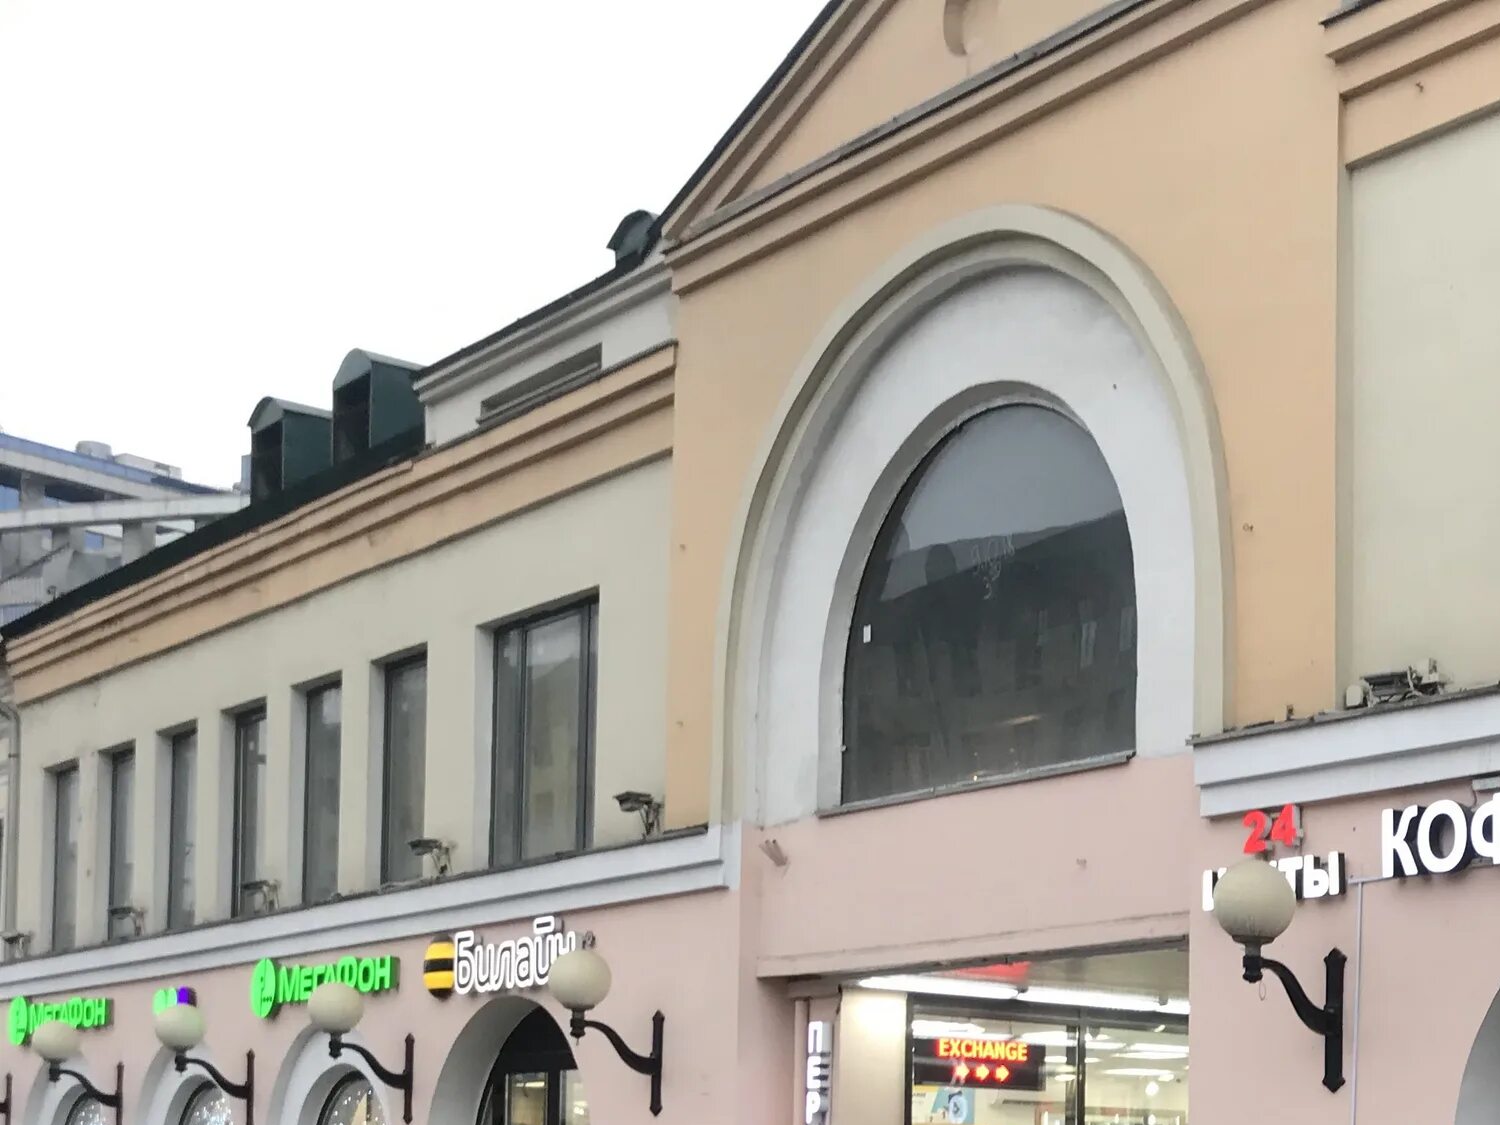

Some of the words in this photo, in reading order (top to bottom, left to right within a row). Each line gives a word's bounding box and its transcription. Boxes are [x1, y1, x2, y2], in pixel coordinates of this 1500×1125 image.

[1241, 802, 1297, 855] 24
[277, 954, 391, 1004] МЕГАФОН
[938, 1039, 1028, 1061] EXCHANGE
